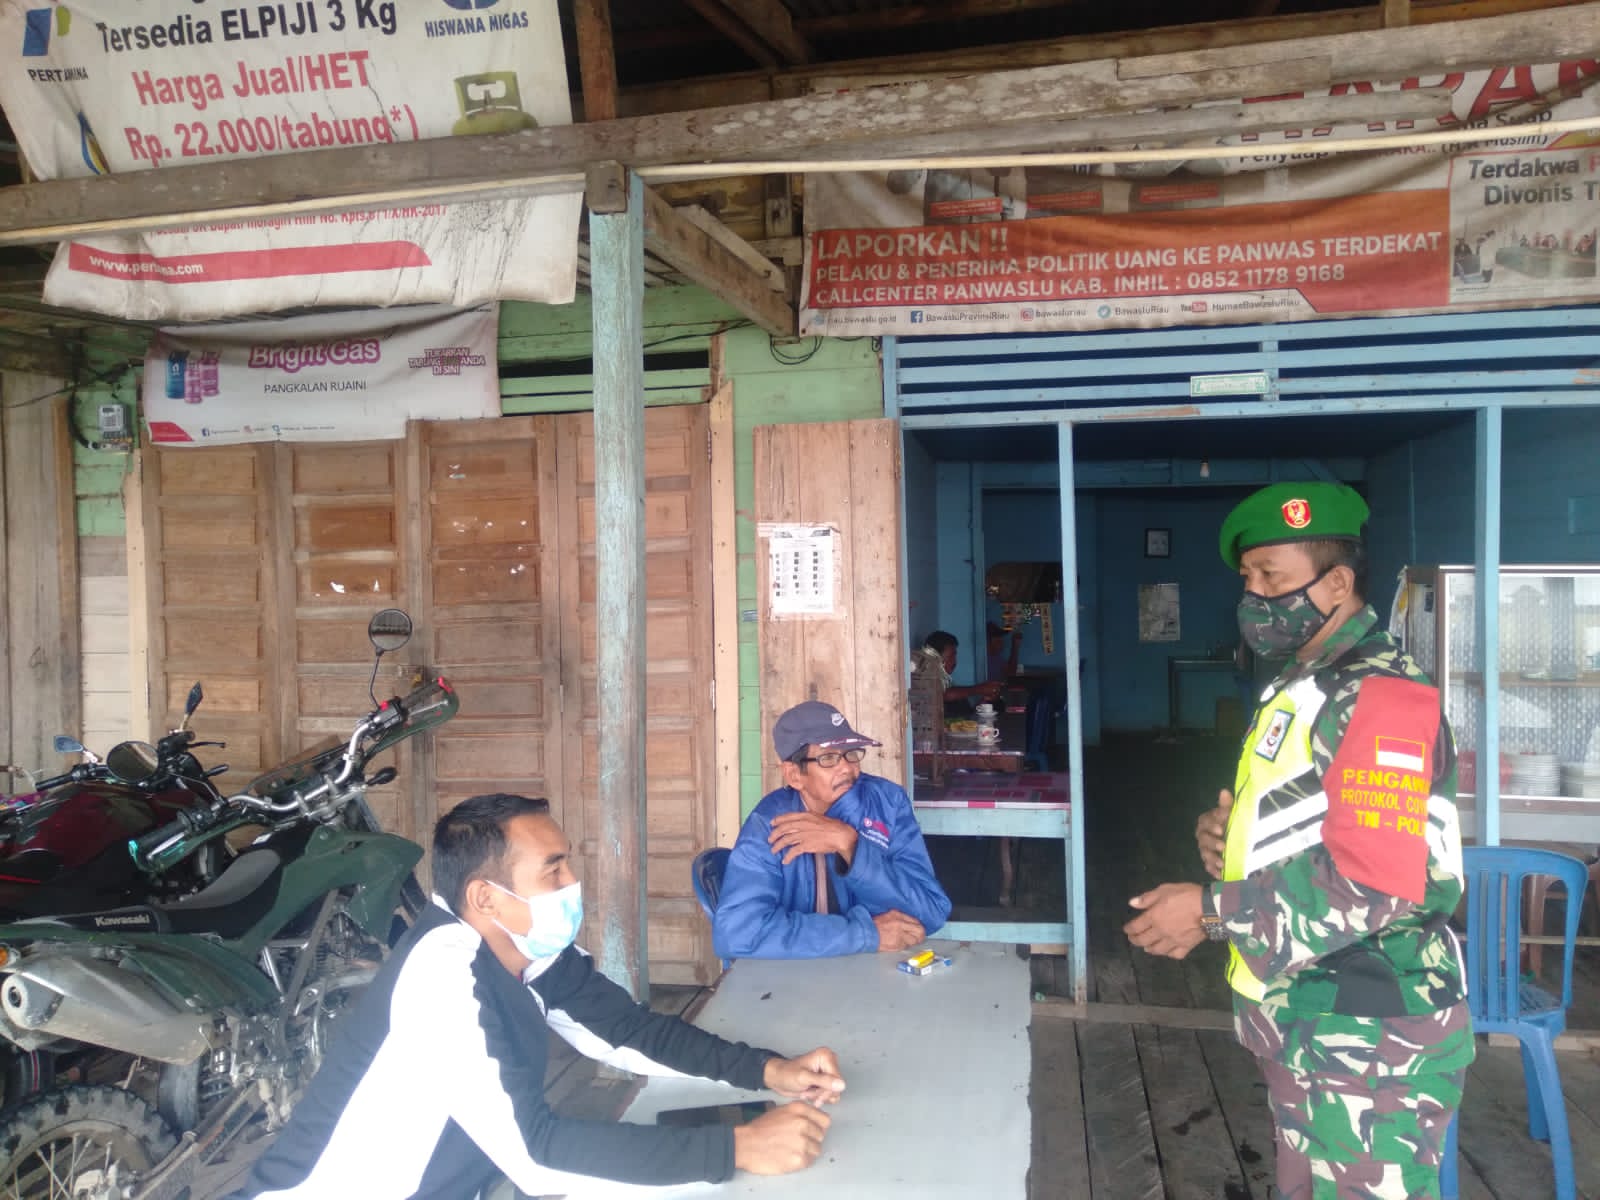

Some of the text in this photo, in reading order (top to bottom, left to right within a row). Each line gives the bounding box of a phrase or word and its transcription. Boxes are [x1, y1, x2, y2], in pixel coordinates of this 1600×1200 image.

[96, 0, 397, 53] Tersedia ELPIJI 3 Kg
[425, 11, 529, 38] HISWANA MIGAS
[27, 66, 89, 82] PERTAMINA
[131, 50, 369, 110] Harga Jual/HET
[123, 123, 172, 168] Rp.
[1469, 157, 1580, 180] Terdakwa
[1484, 183, 1574, 206] Divonis
[816, 231, 1442, 284] PELAKU & PENERIMA POLITIK UANG KE PANWAS TERDEKAT
[818, 228, 1008, 260] LAPORKAN !!
[816, 286, 937, 304] CALLCENTER
[943, 279, 1053, 300] PANWASLU
[1060, 277, 1108, 296] KAB.
[1114, 274, 1169, 293] INHIL
[1187, 270, 1240, 289] 0852
[1246, 267, 1289, 286] 1178
[1295, 264, 1345, 283] 9168
[250, 340, 379, 371] Bright Gas
[264, 380, 367, 393] PANGKALAN RUAINI
[1341, 788, 1401, 811] PROTOKOL
[95, 914, 150, 927] Kawasaki
